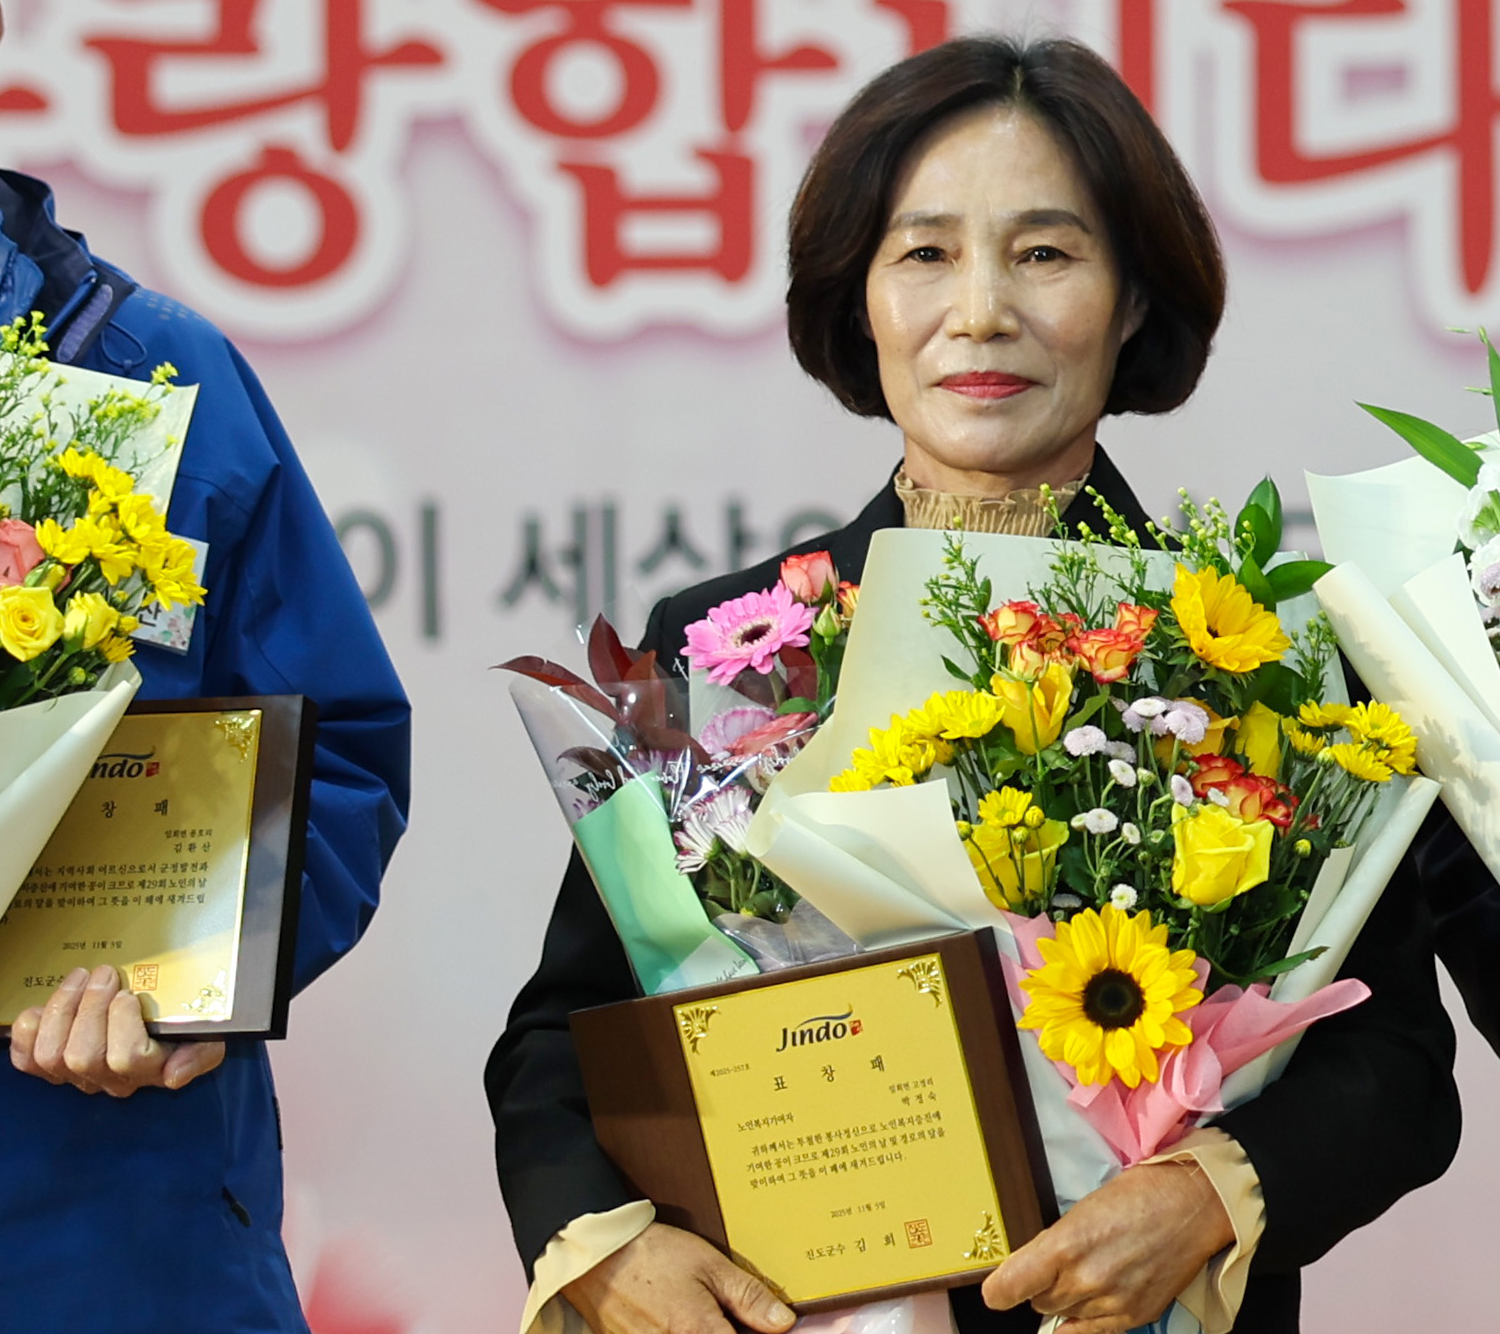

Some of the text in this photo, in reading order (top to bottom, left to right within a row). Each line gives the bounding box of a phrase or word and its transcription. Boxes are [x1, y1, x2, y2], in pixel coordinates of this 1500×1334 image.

[90, 758, 144, 779] ndo
[101, 799, 169, 819] 창 패
[776, 1015, 847, 1052] Jindo
[773, 1054, 885, 1092] 표 창 패
[737, 1112, 794, 1132] 노인복지기여자
[752, 1110, 942, 1156] 귀하께서는 투철한 봉사정신으로 노인복지증진에
[747, 1127, 945, 1173] 기여한 공이 크므로 제29회 노인의 날 및 경로의 달을
[749, 1151, 906, 1189] 맞이하여 그 뜻을 이 패에 새겨드립니다.
[830, 1200, 886, 1219] 2025년 11월 5일
[806, 1232, 896, 1261] 진도군수 김 희
